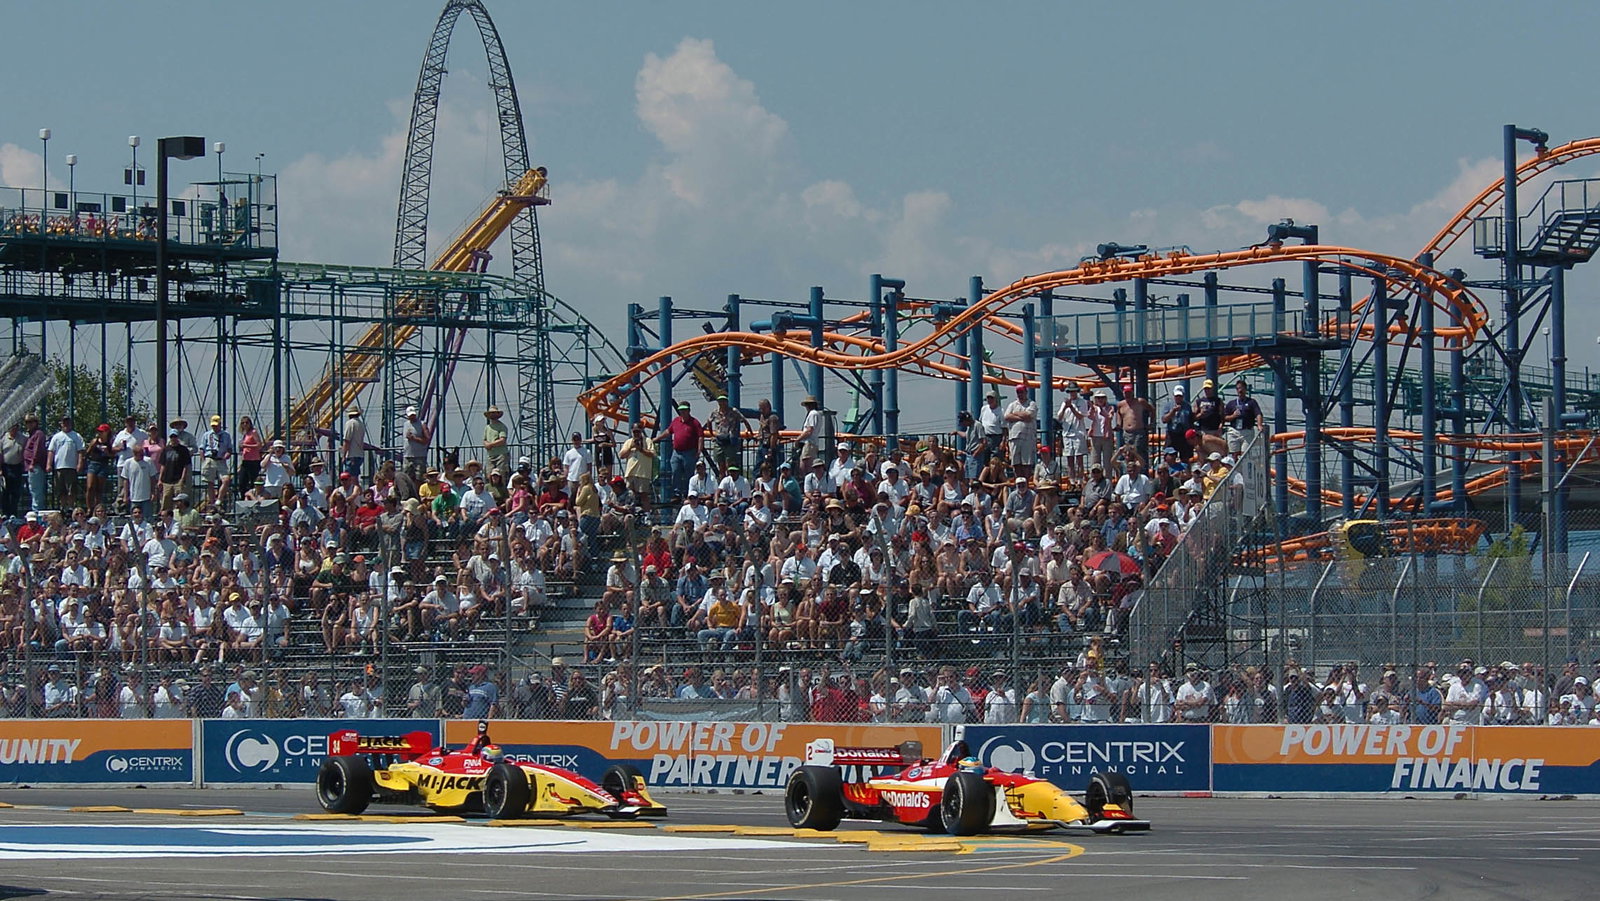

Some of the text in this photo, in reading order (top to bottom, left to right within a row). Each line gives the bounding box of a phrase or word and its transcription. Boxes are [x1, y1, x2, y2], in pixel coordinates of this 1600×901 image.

[610, 721, 788, 752] POWER OF
[1280, 725, 1467, 755] POWER OF
[332, 739, 340, 754] 34
[807, 745, 813, 760] 2
[833, 748, 900, 758] Donald's
[1040, 741, 1186, 763] CENTRIX
[128, 756, 183, 767] CENTRIX
[1042, 765, 1184, 775] FINANCIAL
[1391, 757, 1545, 790] FINANCE
[418, 774, 486, 794] MI-JACK
